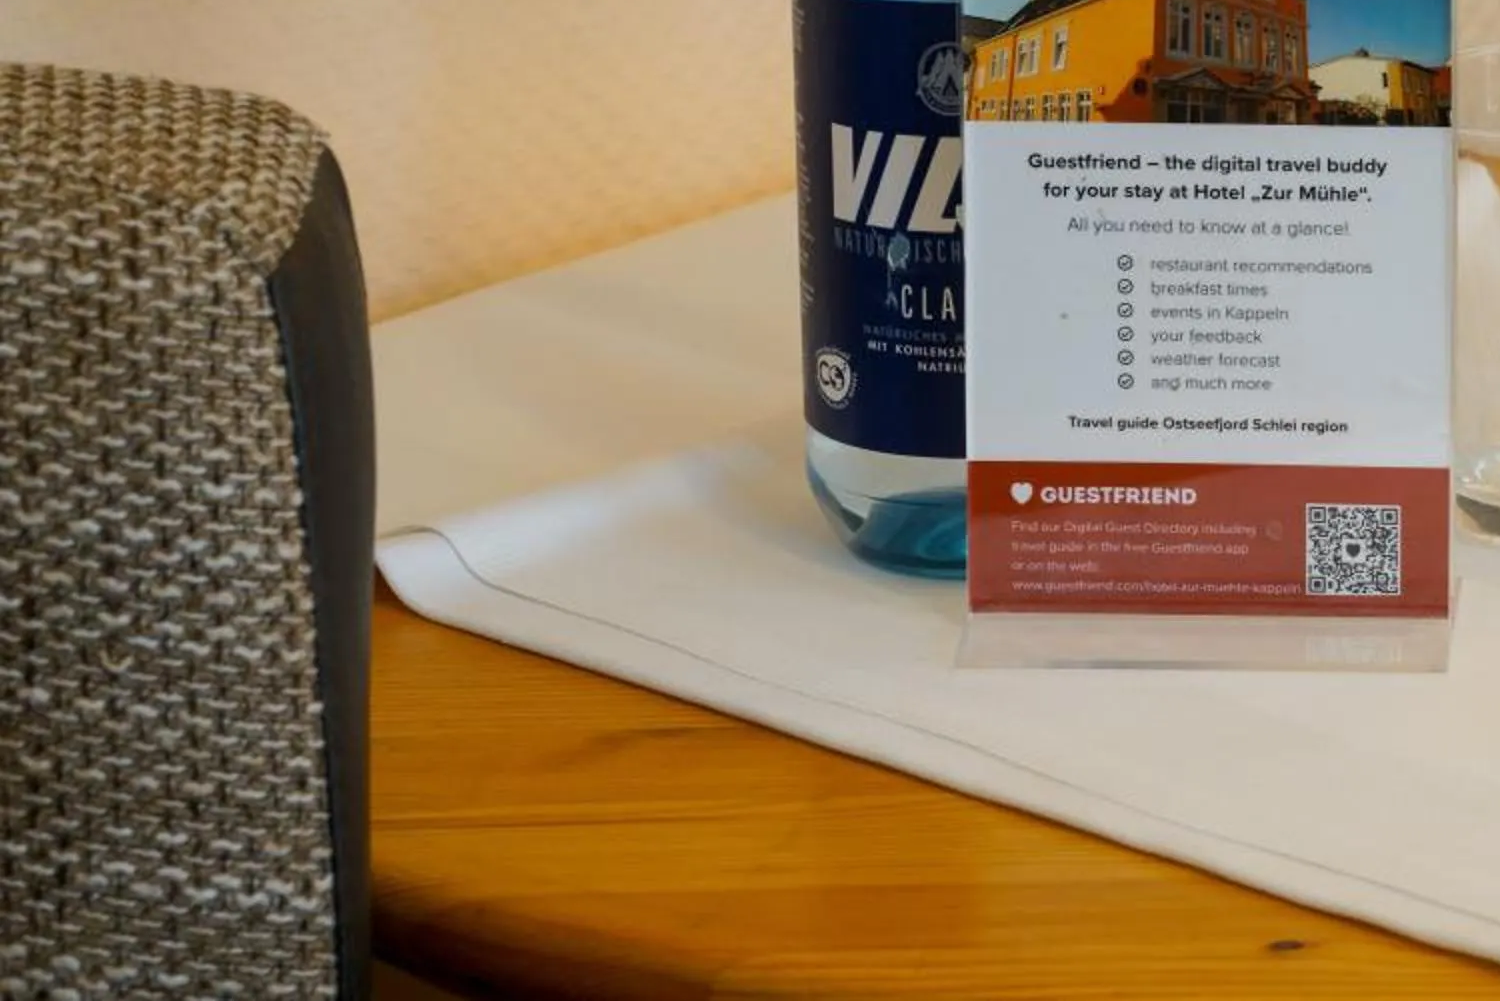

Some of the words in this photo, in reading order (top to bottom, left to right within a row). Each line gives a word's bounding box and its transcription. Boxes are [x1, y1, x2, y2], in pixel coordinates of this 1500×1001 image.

[1027, 152, 1142, 171] Guestfriend
[1164, 154, 1197, 171] the
[1201, 154, 1262, 176] digital
[1265, 156, 1321, 173] travel
[1326, 157, 1388, 178] buddy
[831, 122, 963, 234] VIL
[1042, 181, 1071, 198] for
[1075, 184, 1119, 202] your
[1123, 184, 1165, 203] stay
[1169, 184, 1188, 200] at
[1193, 183, 1246, 201] Hotel
[1066, 216, 1089, 233] All
[1092, 219, 1125, 237] you
[1128, 218, 1174, 235] need
[1178, 219, 1196, 235] to
[1200, 218, 1247, 235] know
[1251, 220, 1267, 236] at
[1270, 222, 1282, 236] a
[1286, 220, 1350, 239] glance!
[1150, 258, 1229, 273] restaurant
[1232, 258, 1374, 275] recommendations
[1150, 280, 1223, 297] breakfast
[1226, 282, 1269, 298] times
[1150, 305, 1204, 321] events
[1207, 305, 1221, 320] in
[1225, 305, 1290, 324] Kappeln
[1150, 330, 1185, 345] your
[1188, 327, 1263, 345] feedback
[1150, 352, 1214, 367] weather
[1218, 352, 1281, 368] forecast
[1150, 375, 1182, 391] and
[1185, 375, 1228, 391] much
[1231, 378, 1273, 392] more
[1067, 415, 1113, 430] Travel
[1116, 416, 1159, 433] guide
[1162, 416, 1249, 434] Ostseefjord
[1252, 418, 1297, 433] Schlei
[1300, 419, 1349, 437] region
[1039, 486, 1198, 506] GUESTFRIEND
[1011, 520, 1039, 533] Find
[1041, 522, 1061, 533] our
[1063, 520, 1103, 535] Digital
[1105, 520, 1141, 534] Guest
[1143, 521, 1199, 536] Directory
[1049, 540, 1084, 554] guide
[1100, 540, 1121, 552] the
[1151, 541, 1223, 554] Guestfriend
[1225, 544, 1250, 556] app
[1046, 560, 1067, 572] the
